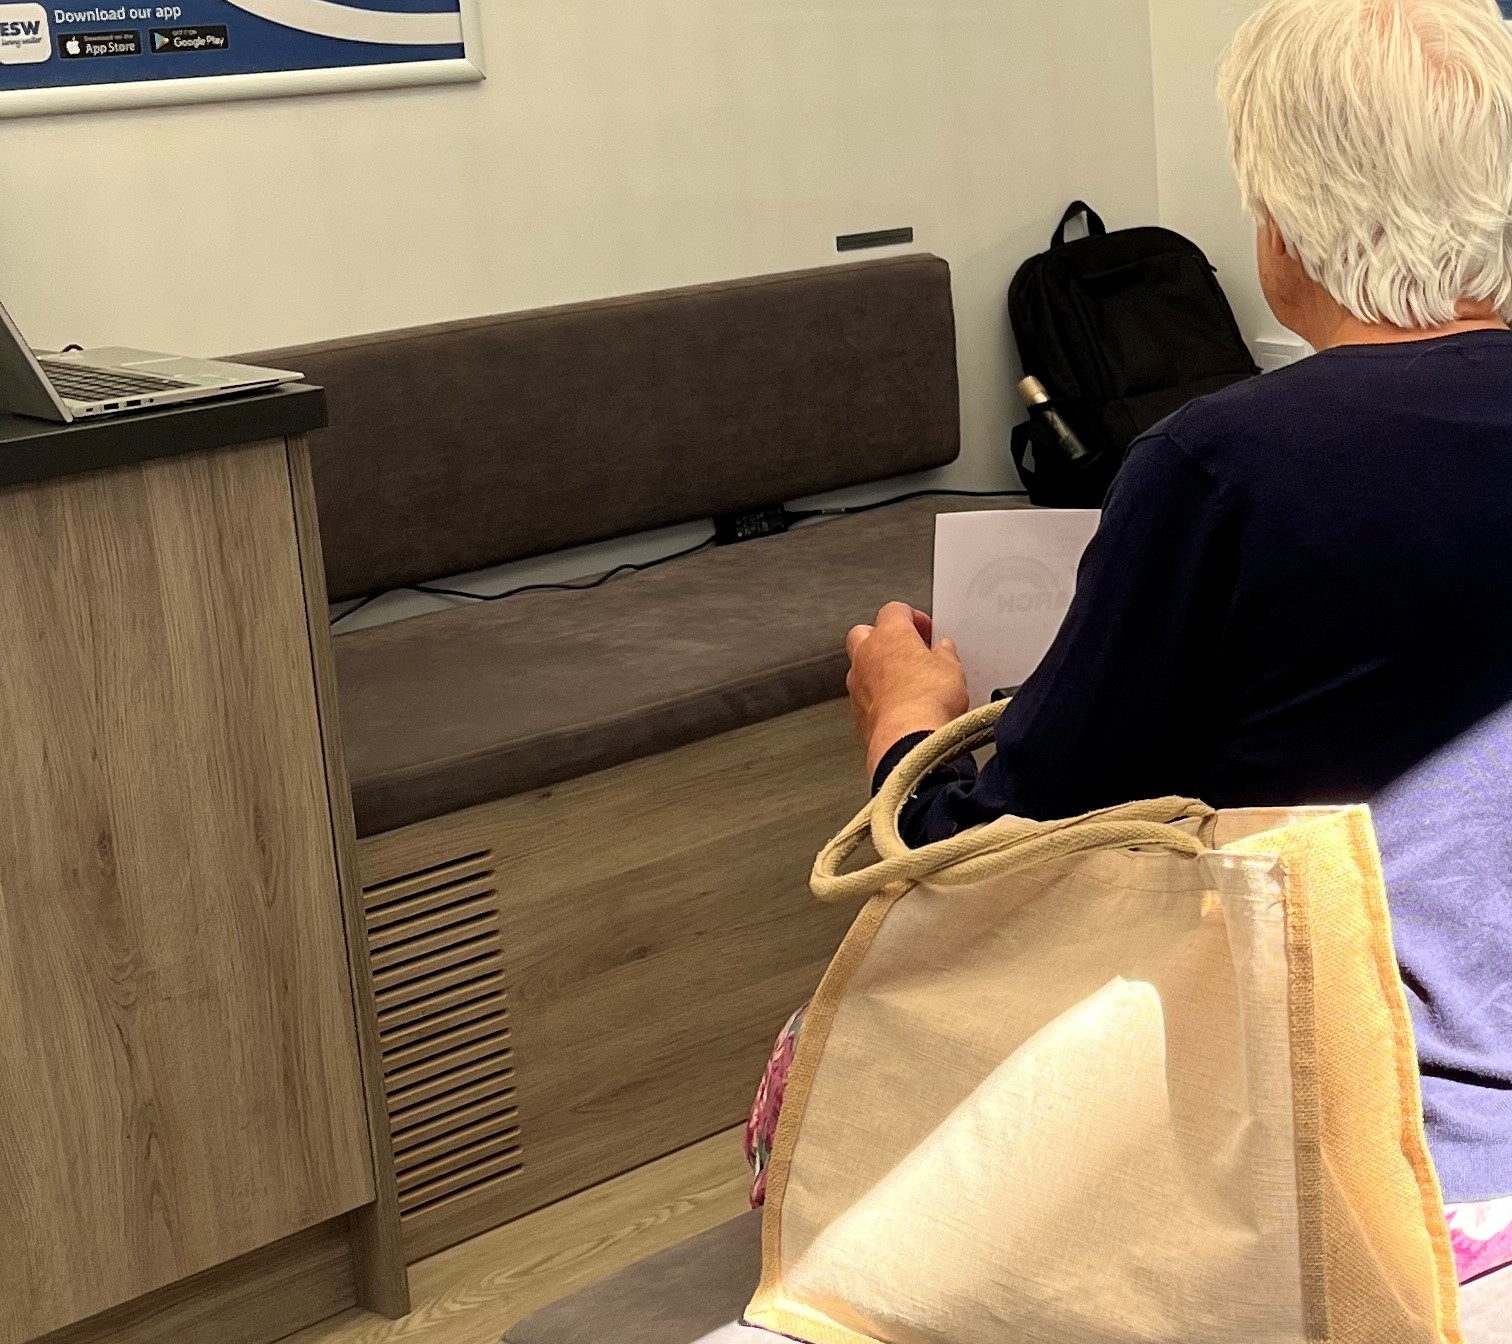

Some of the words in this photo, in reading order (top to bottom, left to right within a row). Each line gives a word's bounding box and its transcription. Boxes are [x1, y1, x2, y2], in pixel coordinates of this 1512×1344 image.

[54, 6, 125, 24] Download
[129, 8, 152, 20] our
[155, 6, 182, 21] app
[85, 42, 107, 56] App
[107, 41, 136, 54] Store
[173, 35, 207, 50] Google
[206, 34, 225, 48] Play
